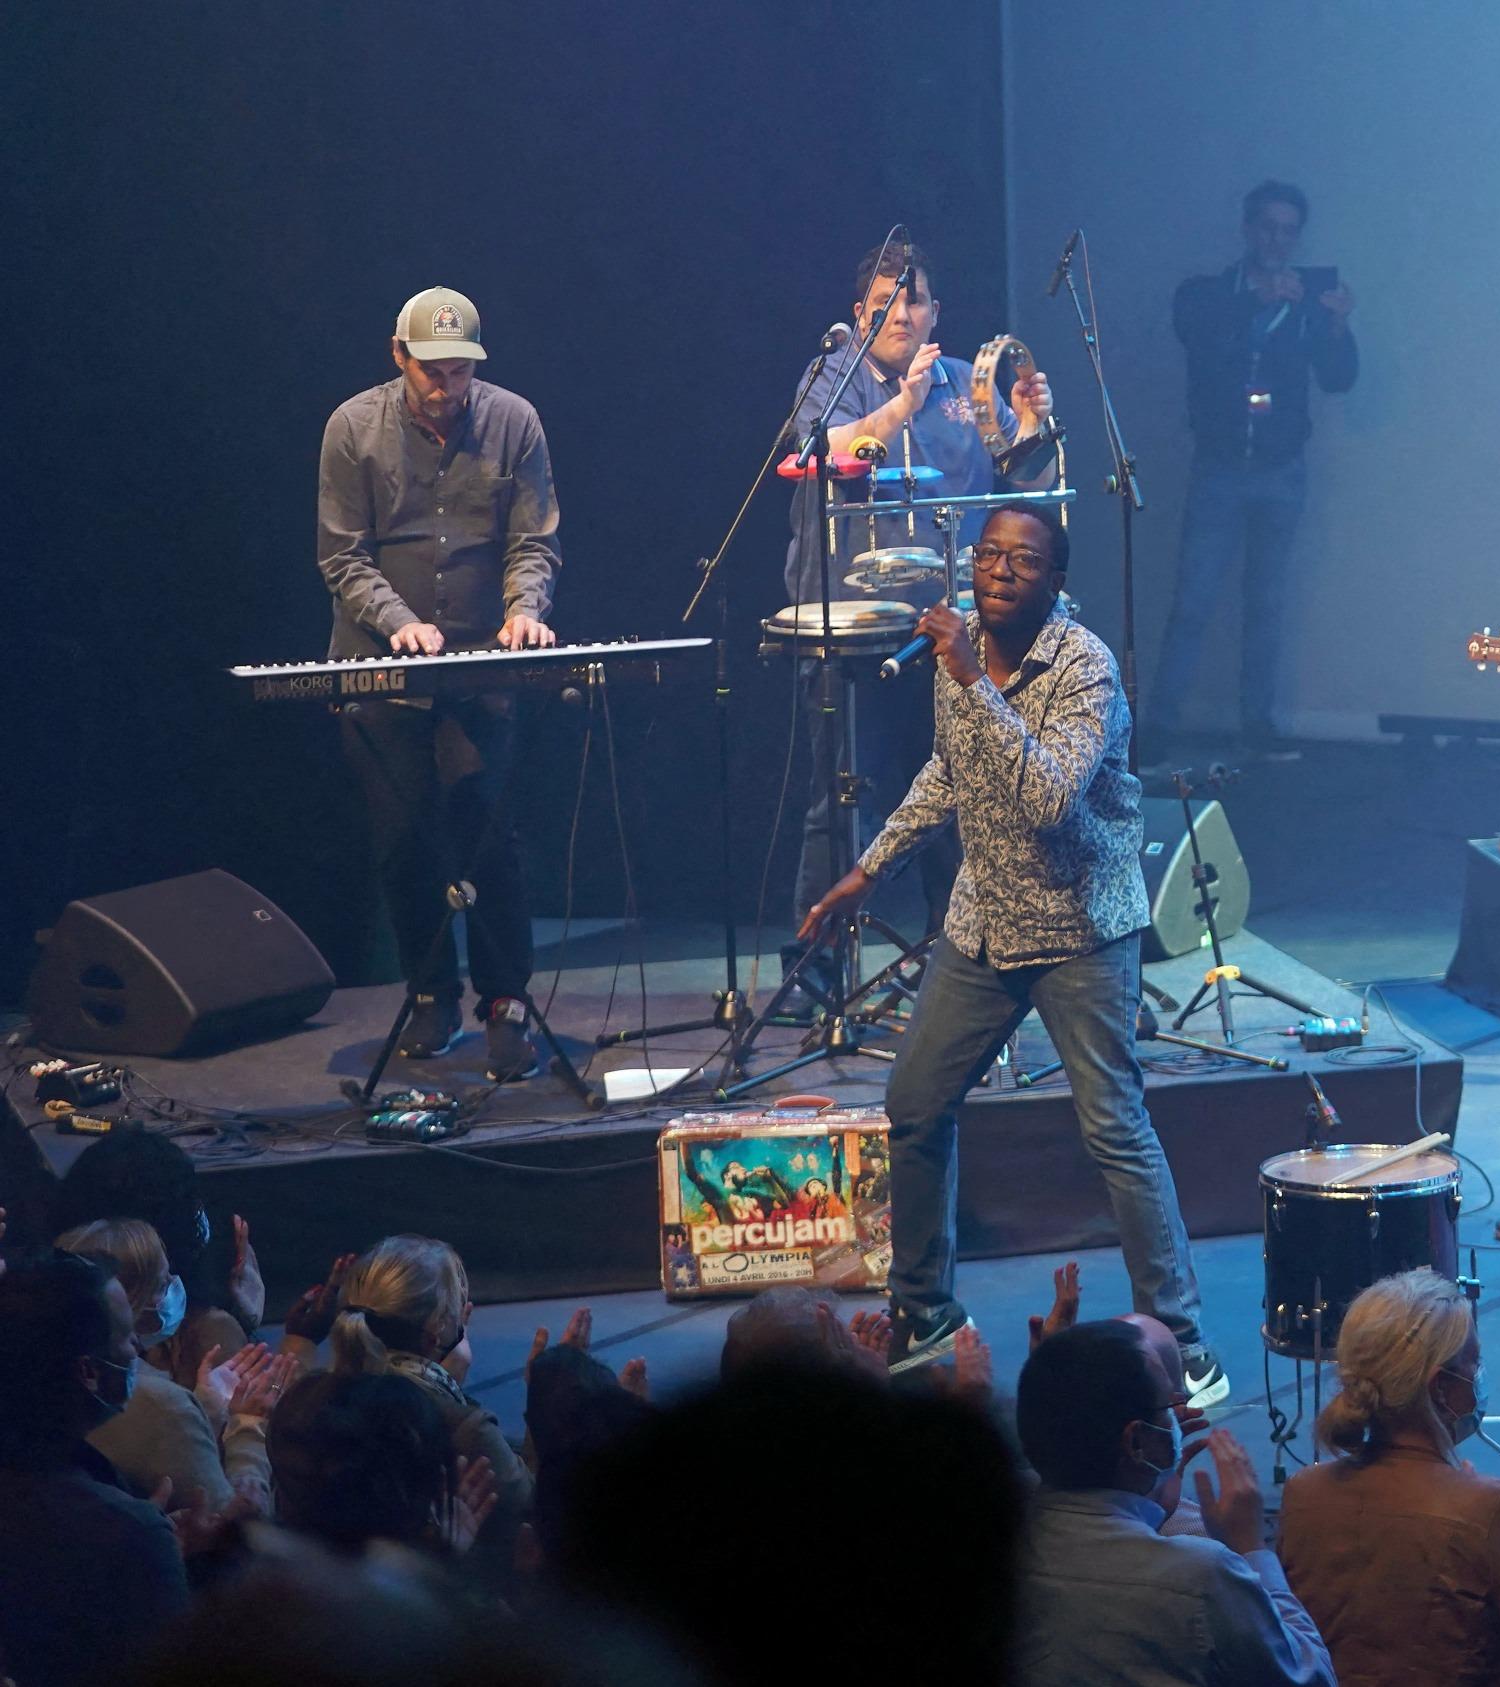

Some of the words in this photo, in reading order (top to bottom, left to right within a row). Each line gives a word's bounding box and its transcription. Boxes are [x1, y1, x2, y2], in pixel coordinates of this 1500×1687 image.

[290, 675, 333, 690] KORG
[341, 668, 405, 694] KORG
[692, 1213, 847, 1253] percujam
[703, 1275, 730, 1285] LUNDI
[740, 1273, 765, 1281] AVRIL
[768, 1271, 788, 1279] 2016
